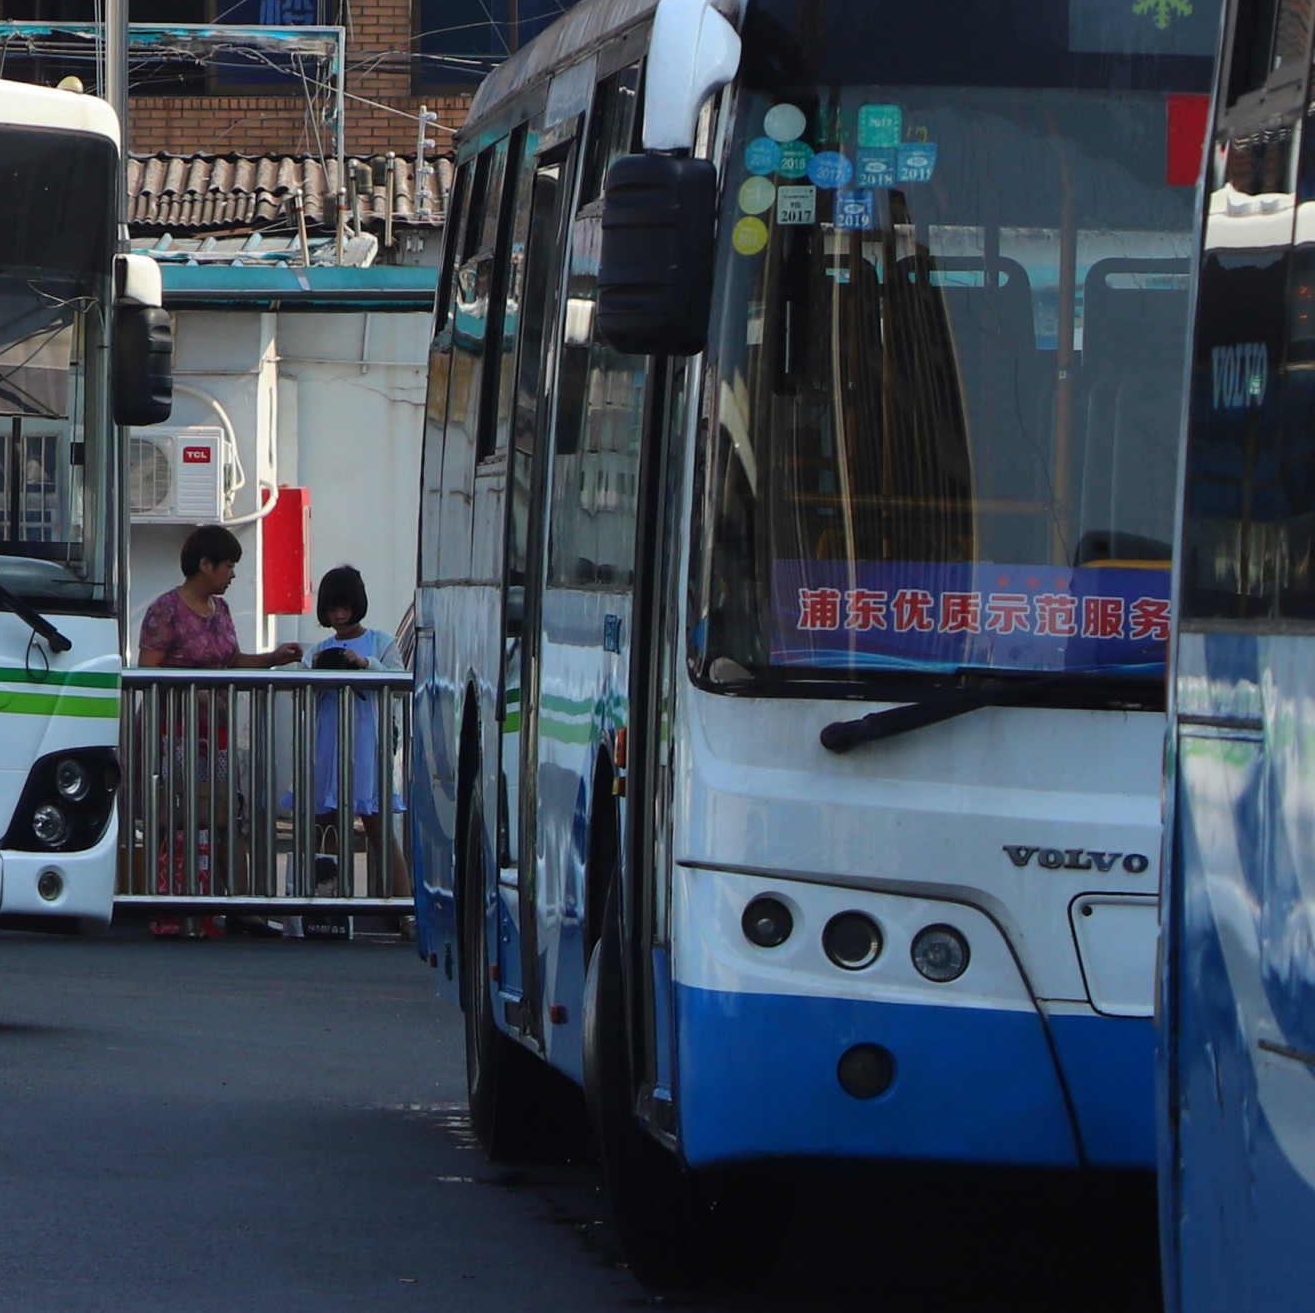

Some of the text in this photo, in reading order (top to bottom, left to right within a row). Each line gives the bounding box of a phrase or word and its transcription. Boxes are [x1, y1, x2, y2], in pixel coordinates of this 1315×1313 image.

[860, 174, 893, 186] 2018
[781, 210, 812, 222] 2017
[838, 214, 870, 227] 2019
[186, 450, 208, 459] TCL
[797, 587, 1171, 641] 浦东优质示范服务
[1003, 844, 1149, 873] VOLVO
